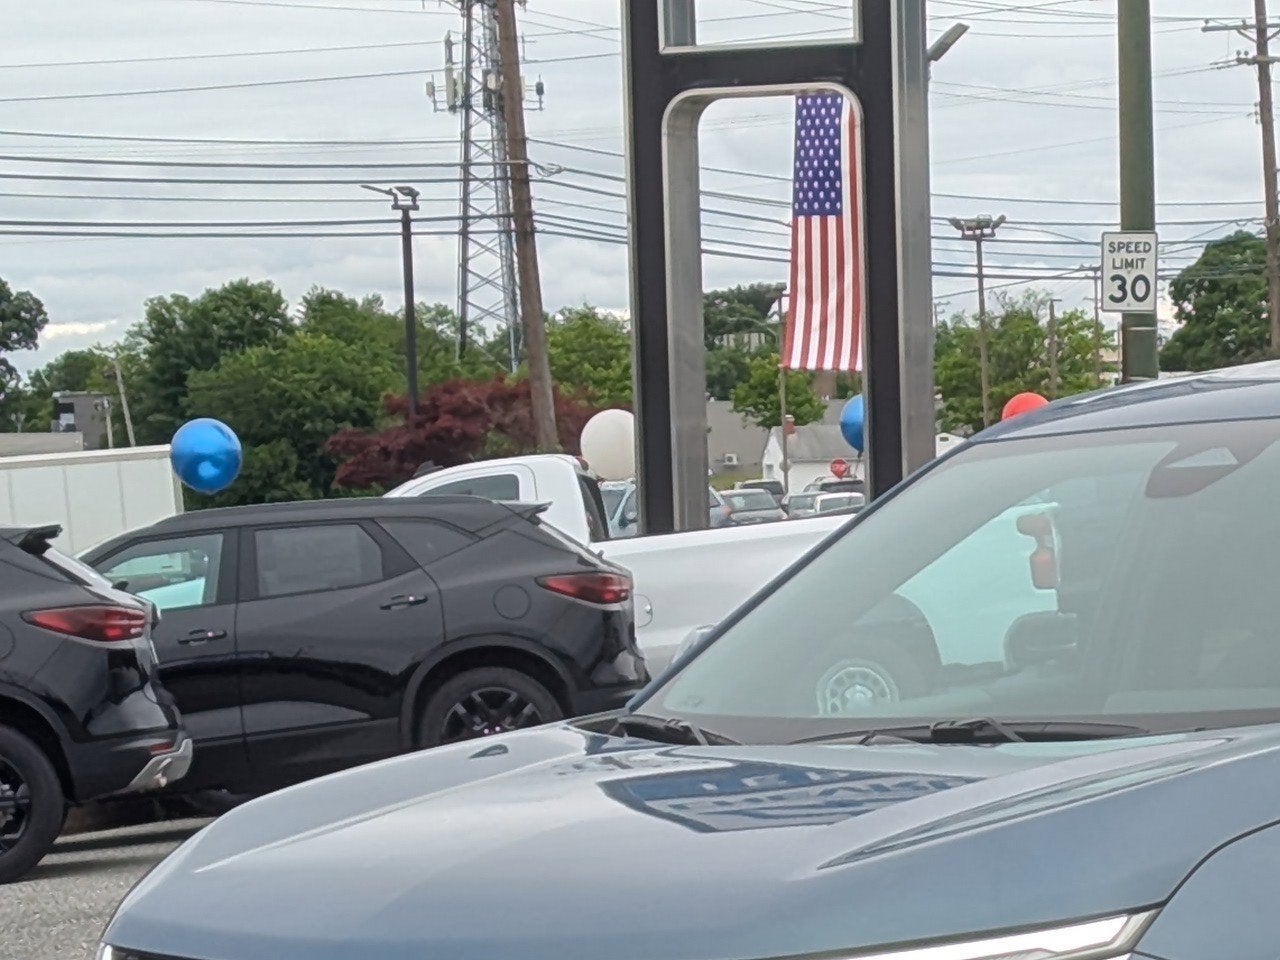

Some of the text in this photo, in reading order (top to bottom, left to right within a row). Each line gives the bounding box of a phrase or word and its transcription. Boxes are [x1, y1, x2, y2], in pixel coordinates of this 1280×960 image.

[1108, 241, 1152, 254] SPEED
[1112, 257, 1147, 270] LIMIT
[1108, 273, 1151, 304] 30
